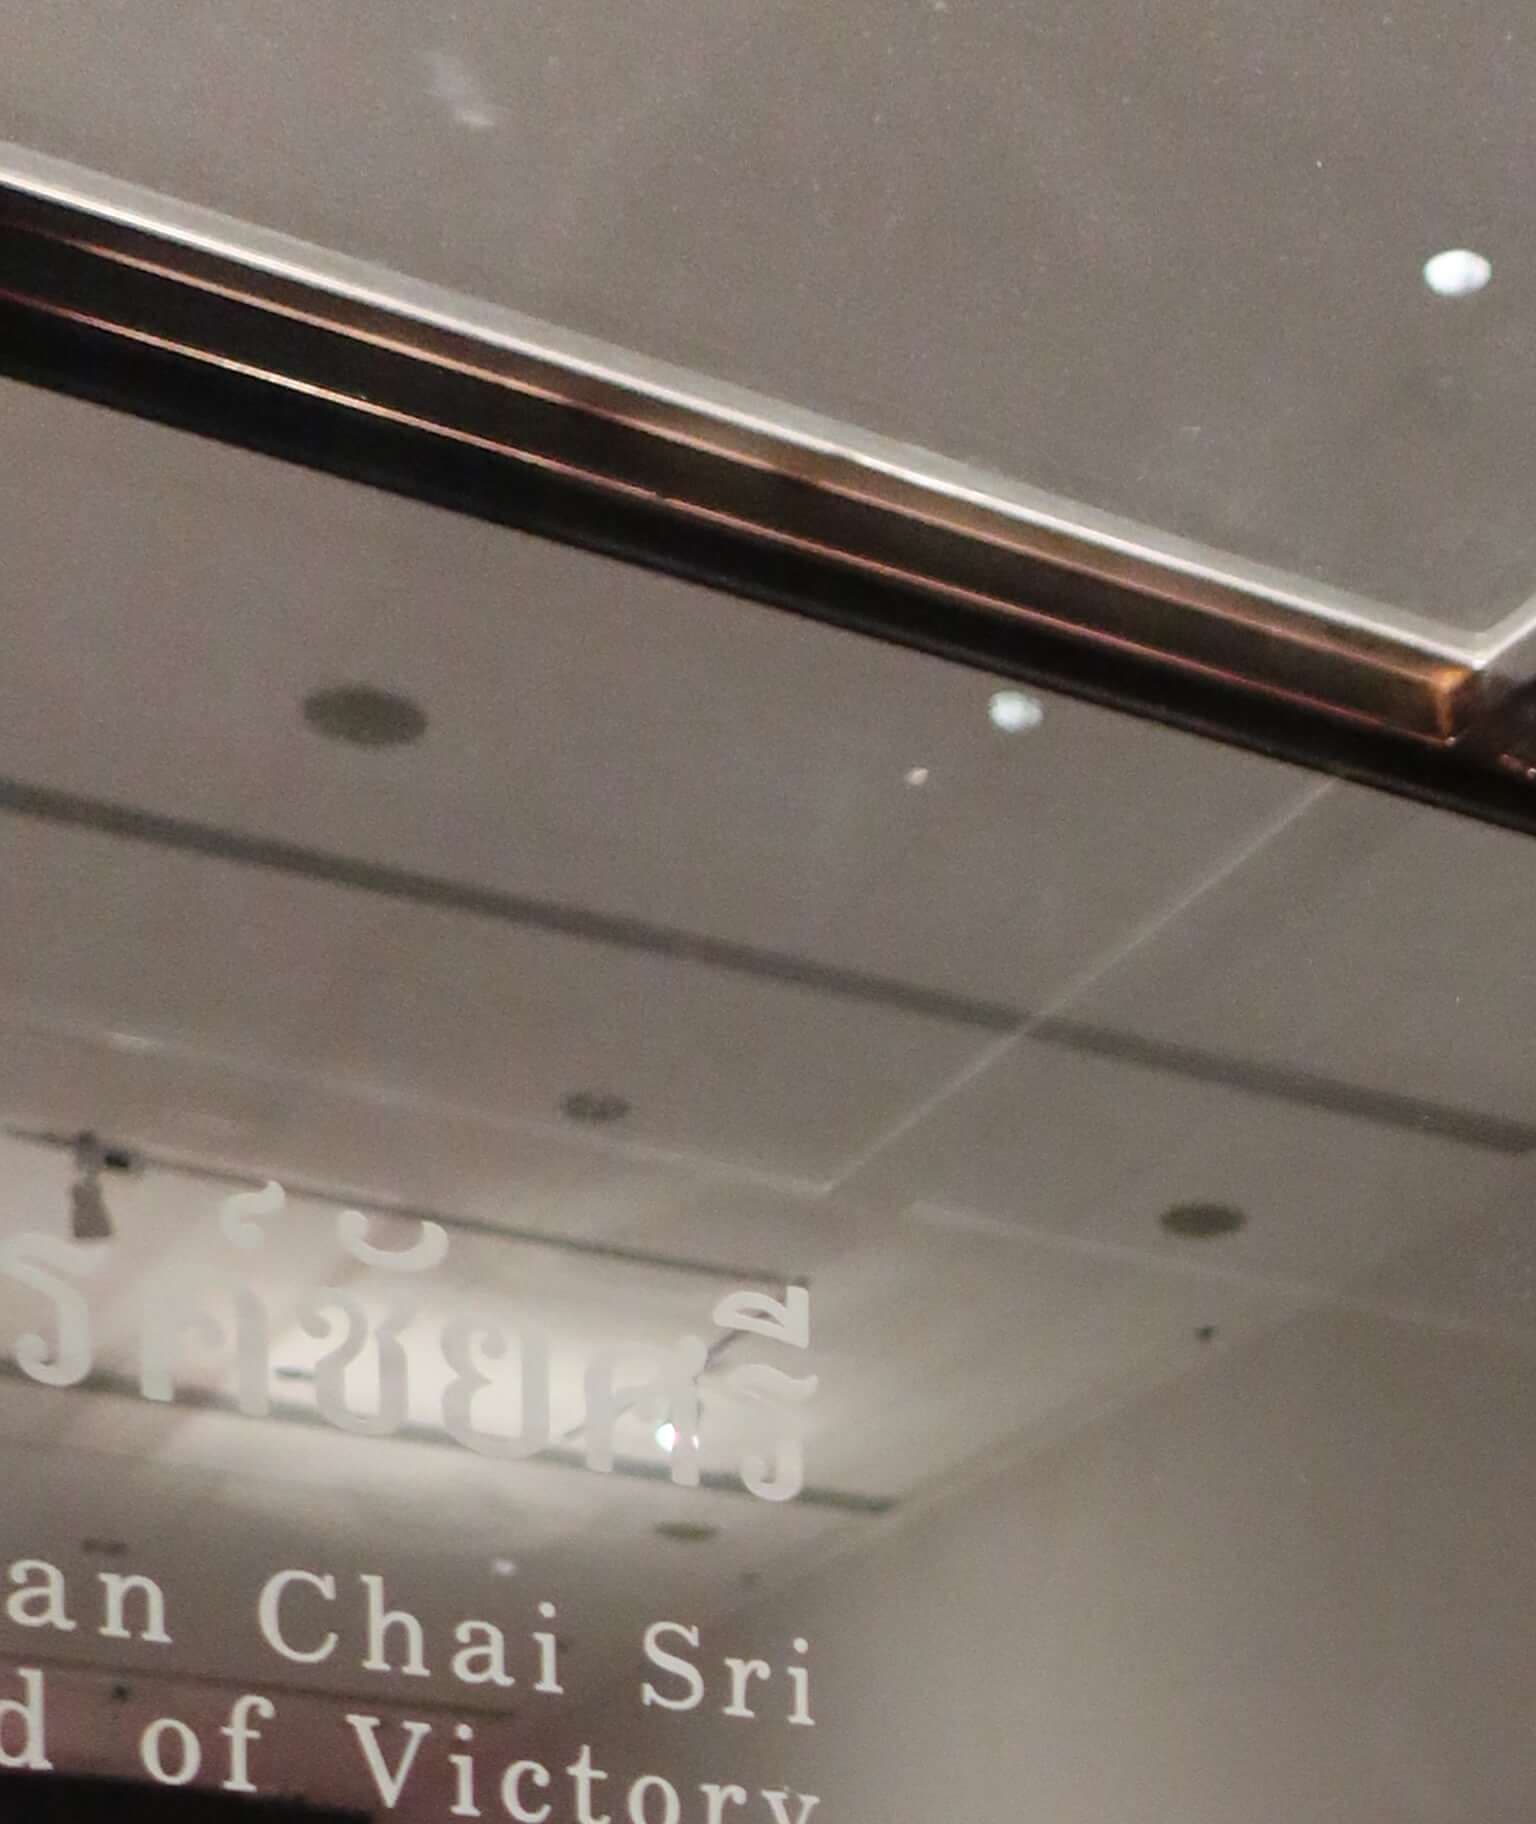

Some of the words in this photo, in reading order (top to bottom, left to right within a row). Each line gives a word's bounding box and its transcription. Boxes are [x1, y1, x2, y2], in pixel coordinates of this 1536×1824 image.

[6, 1558, 173, 1644] an
[258, 1568, 564, 1695] Chai
[641, 1620, 816, 1726] Sri
[0, 1668, 54, 1771] d
[139, 1694, 276, 1793] of
